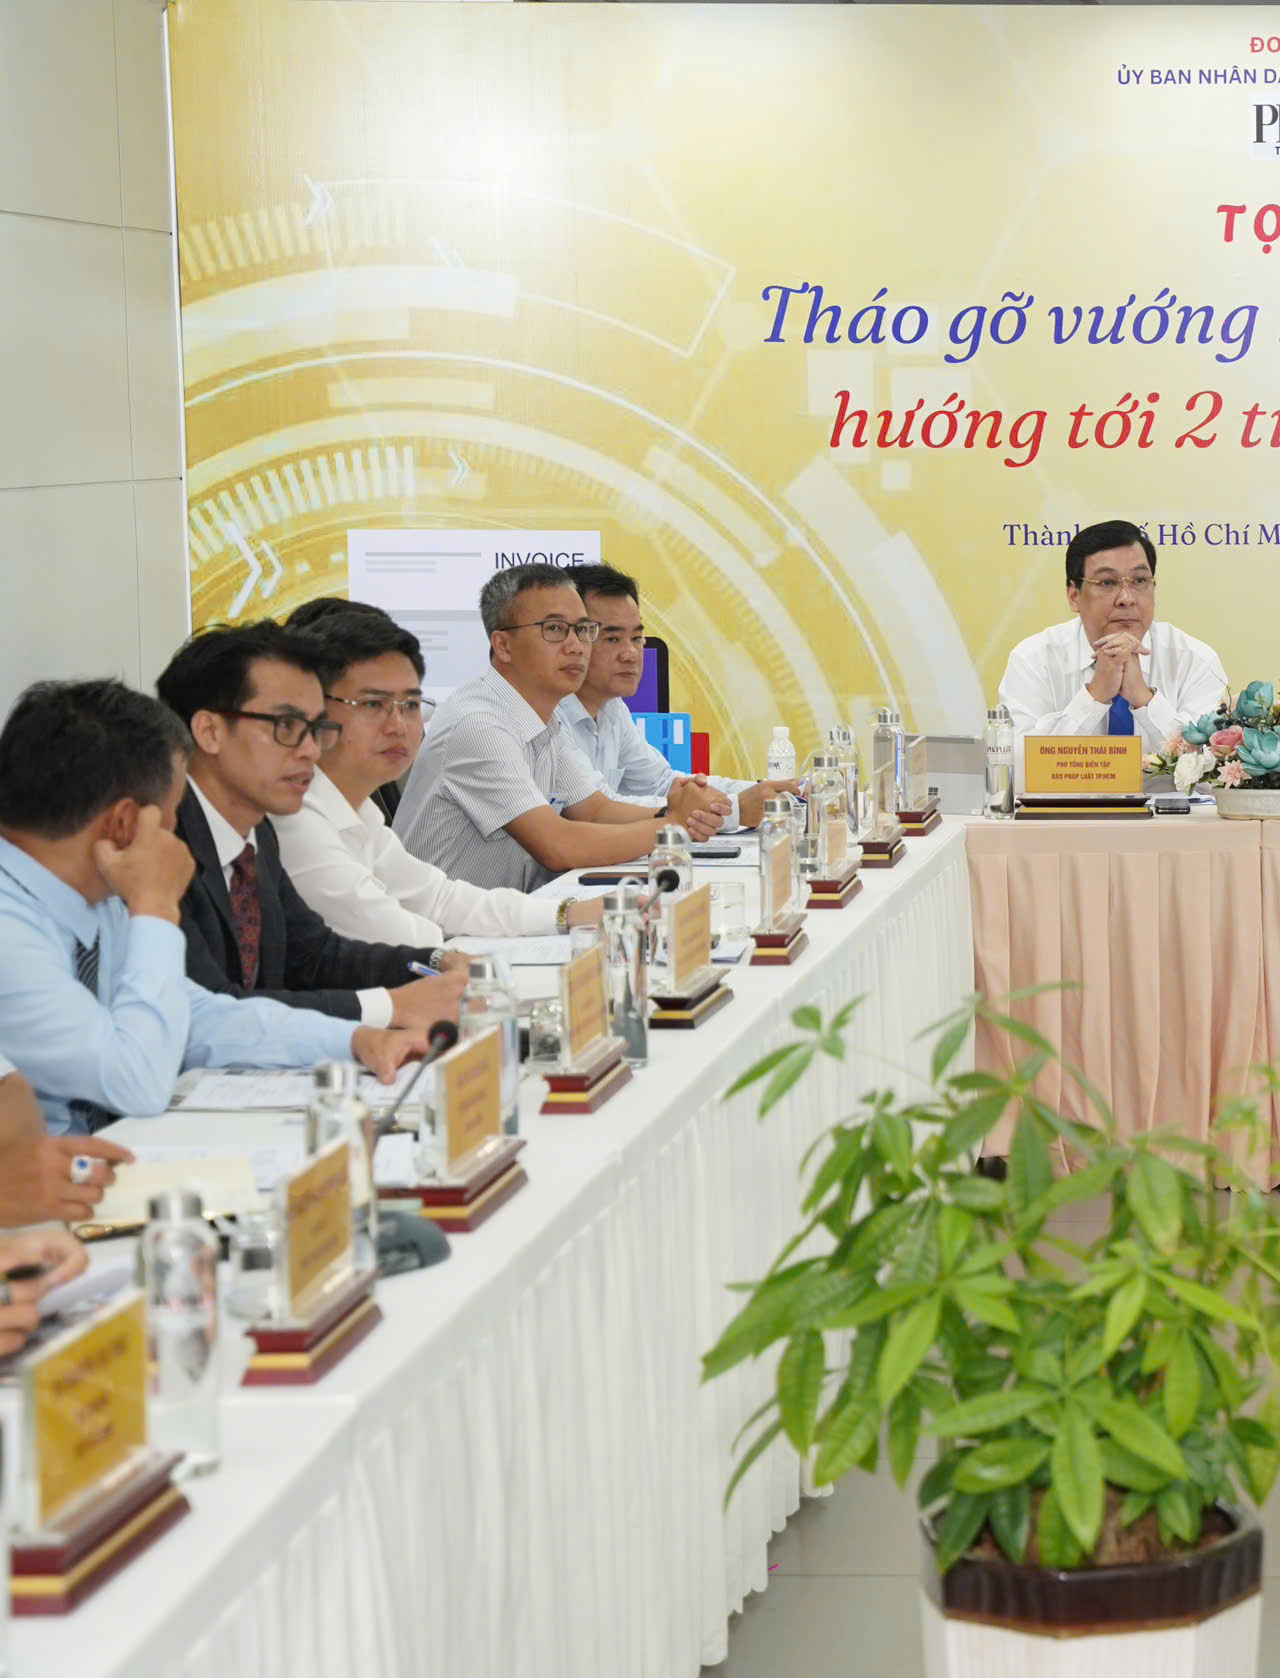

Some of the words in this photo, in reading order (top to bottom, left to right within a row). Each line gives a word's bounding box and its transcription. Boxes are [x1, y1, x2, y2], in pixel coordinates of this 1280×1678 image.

[1117, 64, 1145, 85] ỦY
[1150, 68, 1191, 84] BAN
[1198, 65, 1257, 84] NHÂN
[761, 281, 929, 345] Tháo
[944, 290, 1036, 363] gỡ
[1047, 287, 1260, 363] vướng
[829, 390, 1048, 468] hướng
[1067, 392, 1161, 449] tới
[1174, 390, 1224, 449] 2
[1003, 522, 1080, 546] Thàn
[1157, 522, 1197, 546] Hồ
[1204, 522, 1251, 546] Chí
[495, 552, 585, 570] INVOICE
[1040, 746, 1056, 755] ÔNG
[1058, 744, 1089, 755] NGUYỄN
